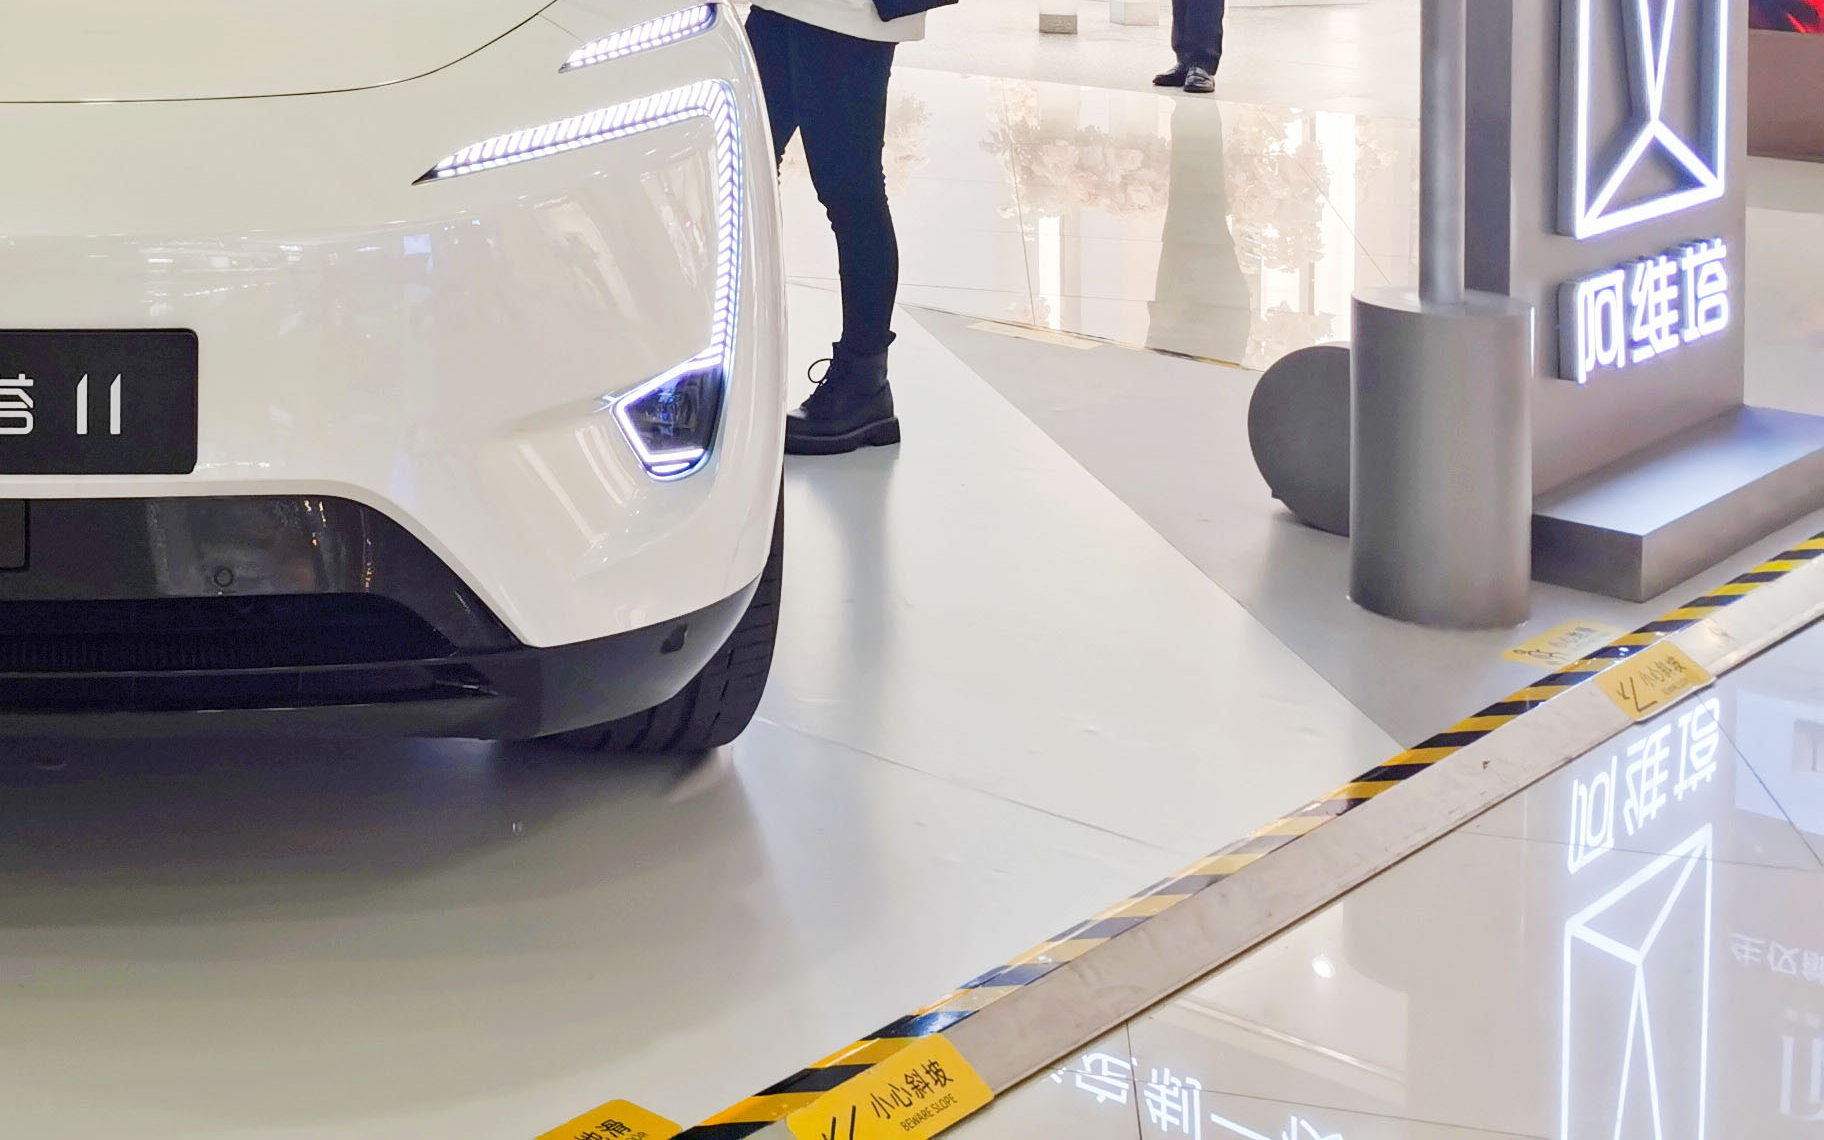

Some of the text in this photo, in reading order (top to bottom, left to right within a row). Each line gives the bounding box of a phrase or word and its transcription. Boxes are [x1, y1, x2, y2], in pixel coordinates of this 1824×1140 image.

[1577, 237, 1729, 384] 阿维塔
[870, 1059, 954, 1120] 小心斜坡
[900, 1092, 958, 1132] BEWARE SLOPE
